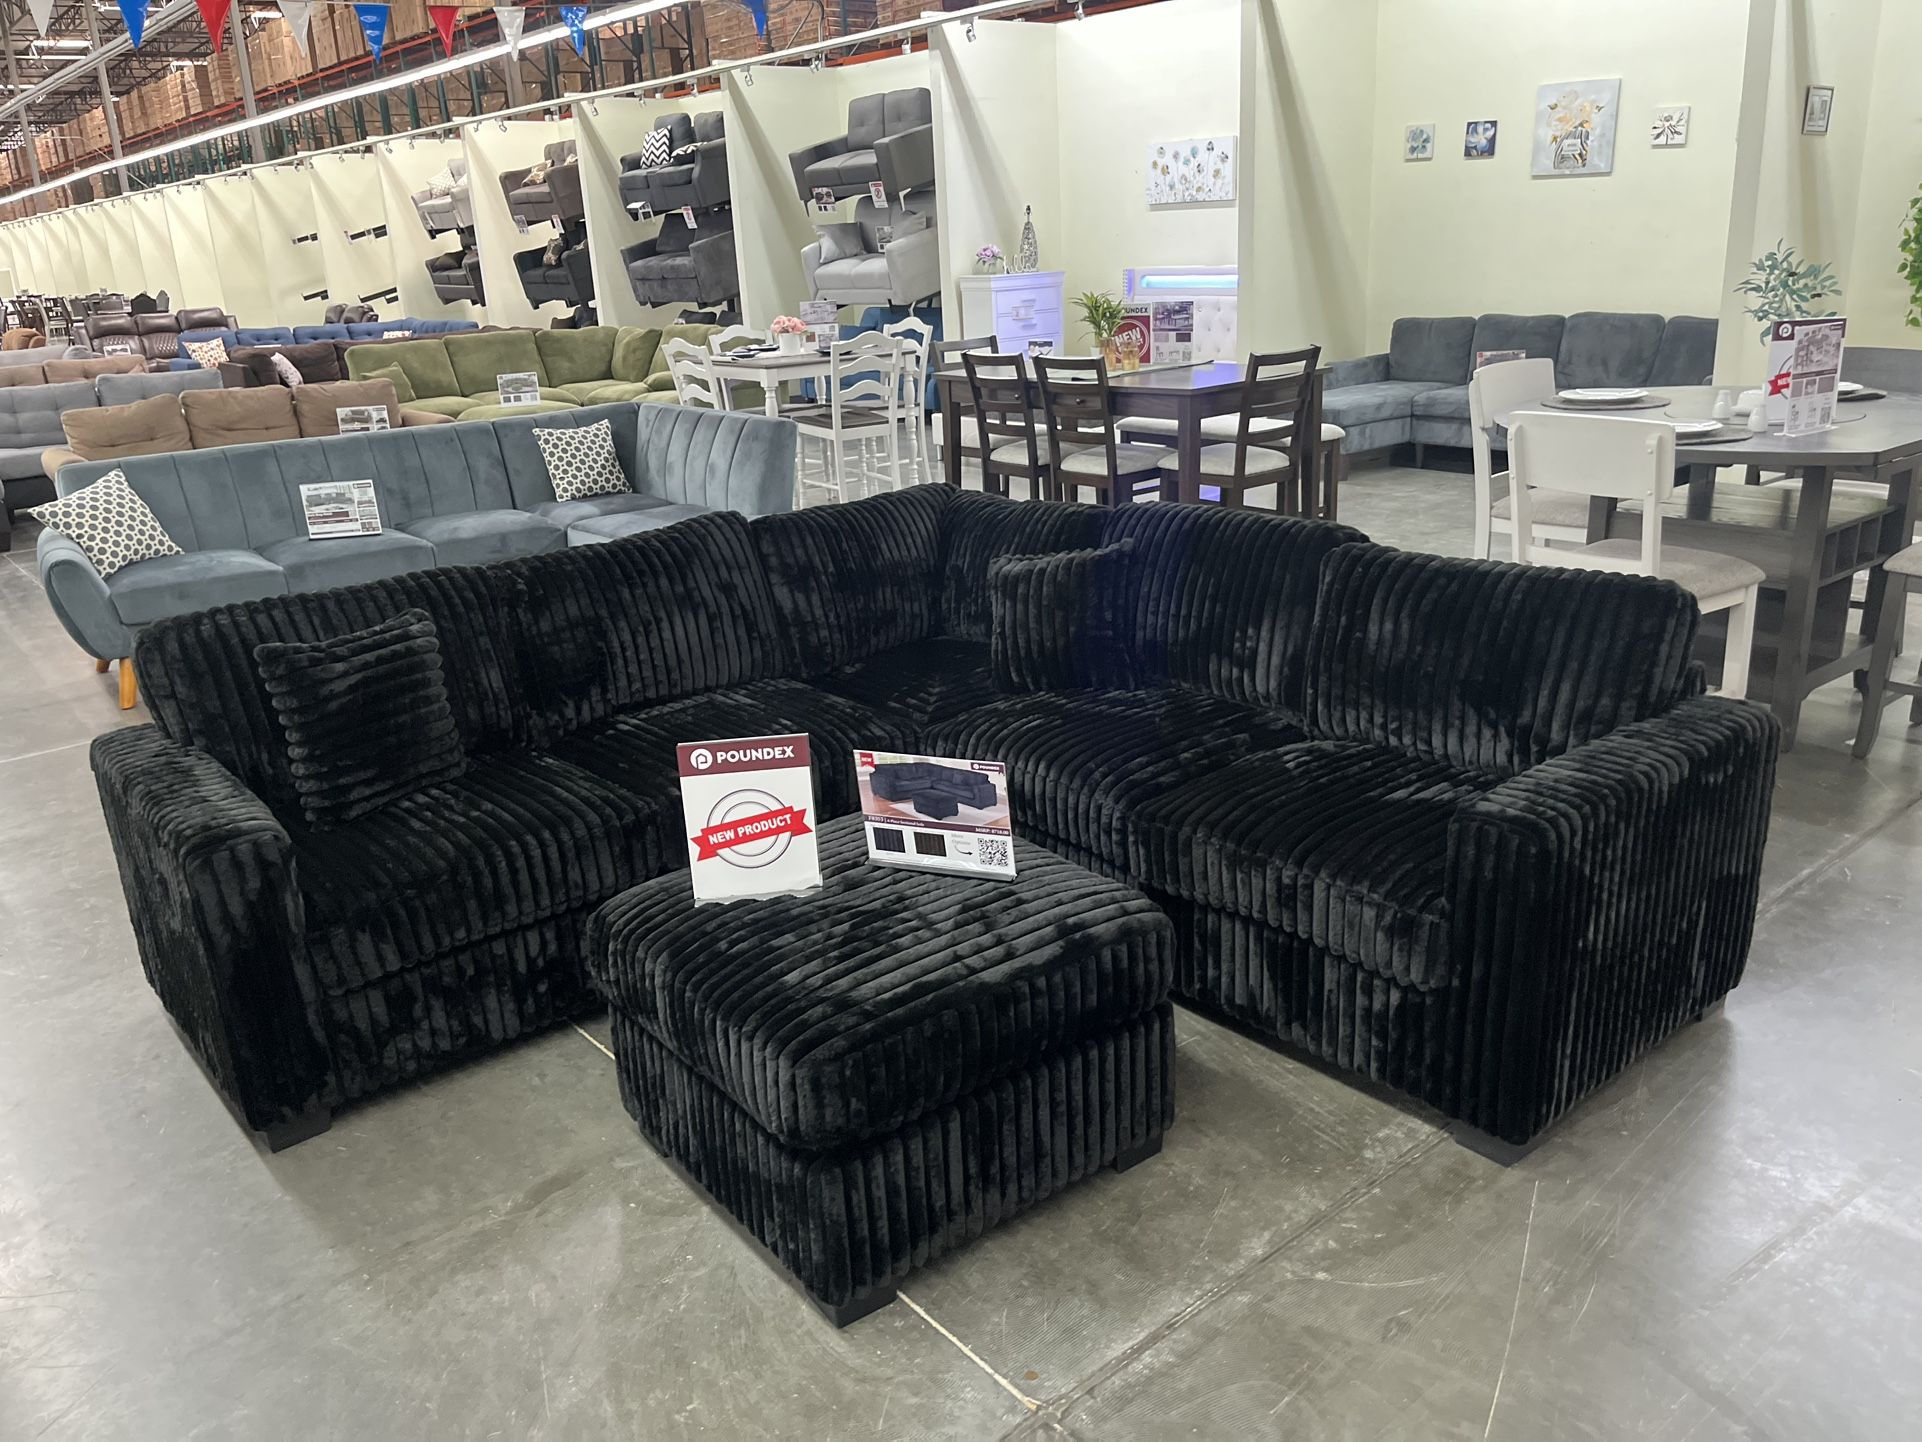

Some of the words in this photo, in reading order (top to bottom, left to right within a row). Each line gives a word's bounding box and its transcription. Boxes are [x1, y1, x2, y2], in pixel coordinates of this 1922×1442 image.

[717, 746, 794, 763] POUNDEX
[708, 829, 735, 845] NEW
[737, 814, 792, 837] PRODUCT
